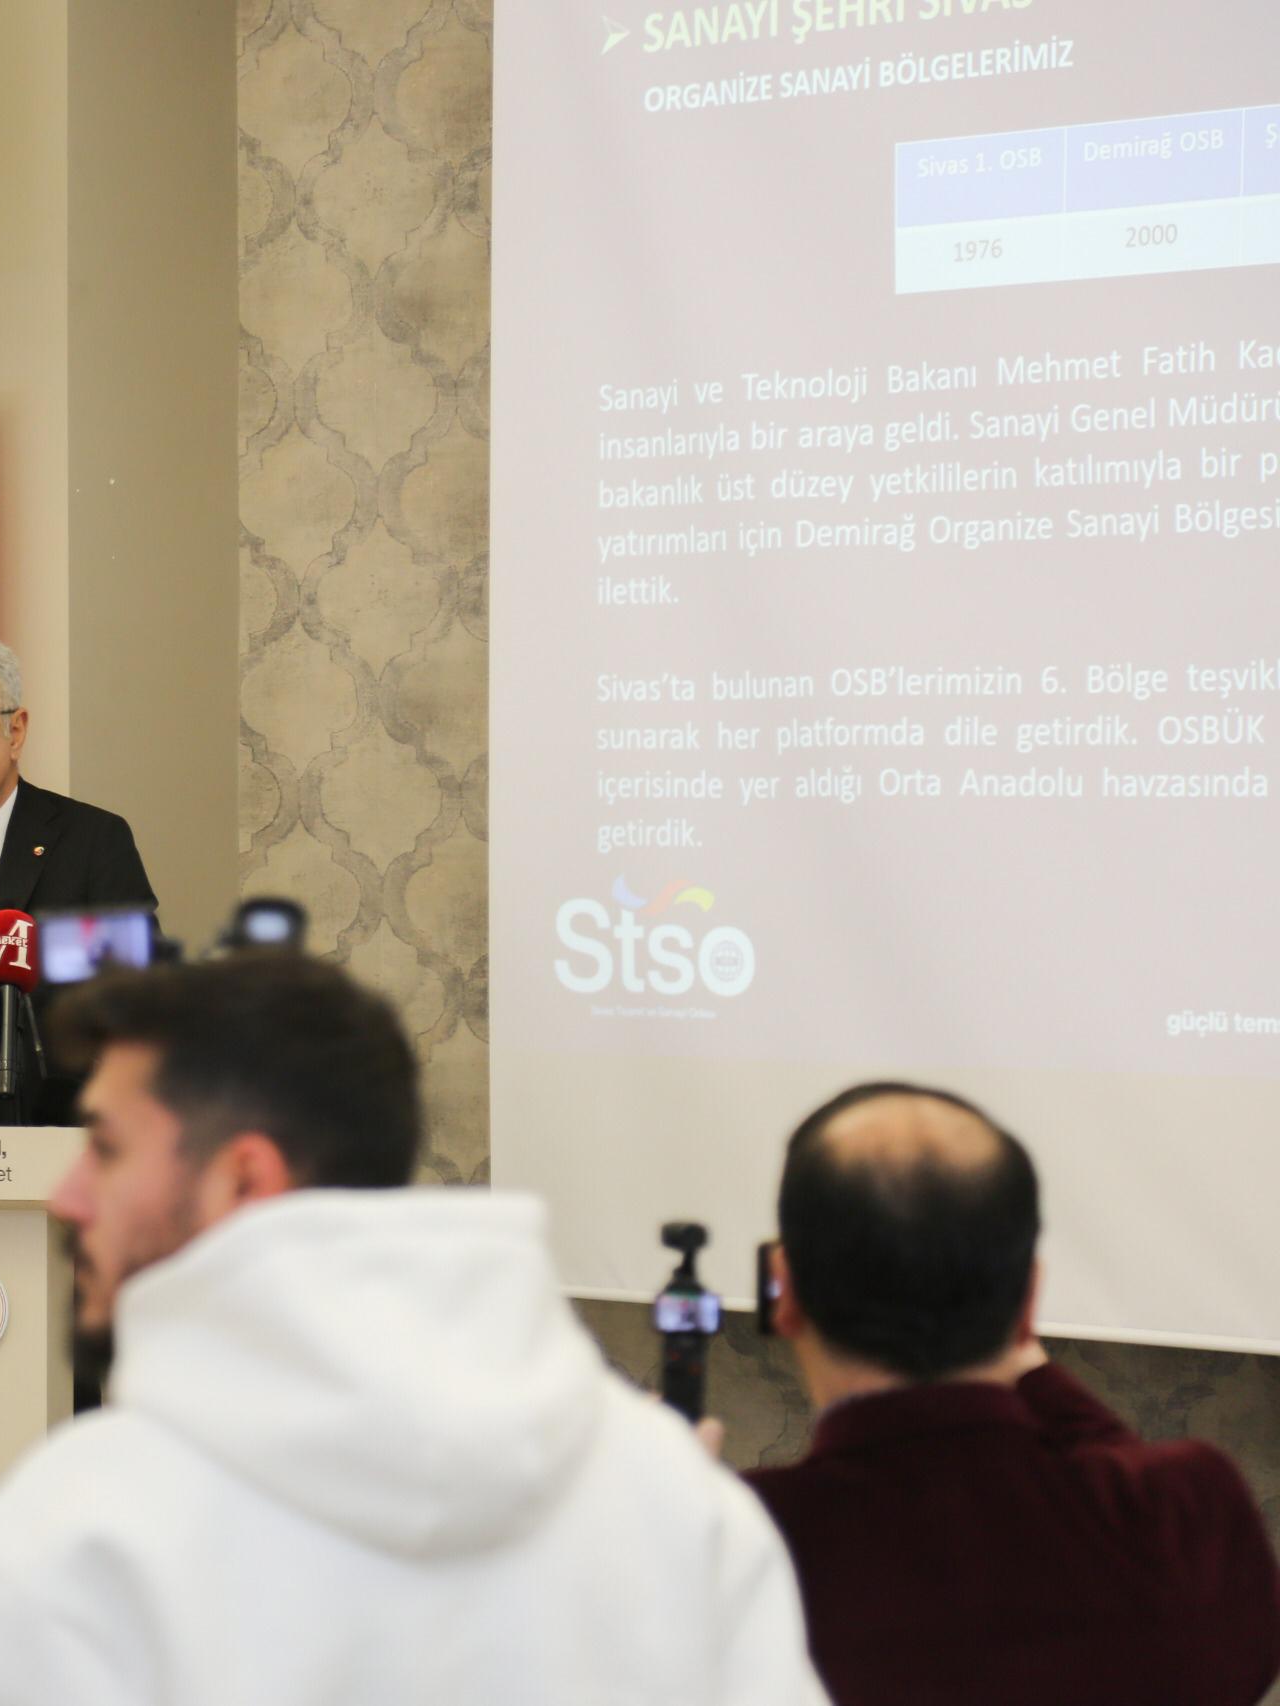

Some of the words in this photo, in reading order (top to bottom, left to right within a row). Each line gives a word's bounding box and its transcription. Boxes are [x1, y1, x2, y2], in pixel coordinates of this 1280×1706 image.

[644, 71, 773, 112] ORGANİZE
[780, 56, 871, 98] SANAYİ
[879, 39, 1074, 88] BÖLGELERİMİZ
[917, 155, 969, 178] Sivas
[975, 152, 993, 173] 1.
[999, 147, 1042, 170] OSB
[1083, 131, 1173, 162] Demirağ
[1179, 128, 1224, 152] OSB
[953, 238, 1003, 263] 1976
[1125, 223, 1178, 248] 2000
[599, 378, 678, 415] Sanayi
[694, 381, 724, 404] ve
[741, 367, 867, 404] Teknoloji
[887, 361, 977, 394] Bakanı
[997, 350, 1121, 385] Mehmet
[1143, 341, 1216, 376] Fatih
[1239, 339, 1280, 369] Ka
[599, 422, 740, 461] insanlarıyla
[751, 421, 788, 450] bir
[798, 423, 874, 453] araya
[884, 411, 959, 452] geldi.
[970, 404, 1059, 443] Sanayi
[1070, 397, 1156, 433] Genel
[598, 474, 703, 508] bakanlık
[717, 473, 756, 502] üst
[770, 469, 854, 504] düzey
[869, 461, 1017, 503] yetkililerin
[1035, 449, 1182, 489] katılımıyla
[1201, 447, 1242, 478] bir
[597, 524, 727, 564] yatırımları
[739, 520, 782, 557] için
[796, 513, 916, 553] Demirağ
[929, 511, 1053, 550] Organize
[1067, 504, 1159, 542] Sanayi
[598, 575, 679, 605] ilettik.
[712, 670, 814, 701] bulunan
[1040, 665, 1067, 694] 6.
[1087, 662, 1169, 701] Bölge
[597, 721, 700, 750] sunarak
[717, 720, 761, 750] her
[777, 716, 925, 754] platformda
[944, 715, 998, 746] dile
[1015, 714, 1137, 753] getirdik.
[1158, 707, 1265, 745] OSBÜK
[598, 769, 724, 805] içerisinde
[739, 777, 780, 806] yer
[795, 765, 862, 804] aldığı
[879, 767, 942, 797] Orta
[959, 766, 1083, 797] Anadolu
[1102, 765, 1268, 798] havzasında
[597, 818, 703, 854] getirdik.
[554, 897, 756, 998] Stso
[1233, 1012, 1280, 1034] tem
